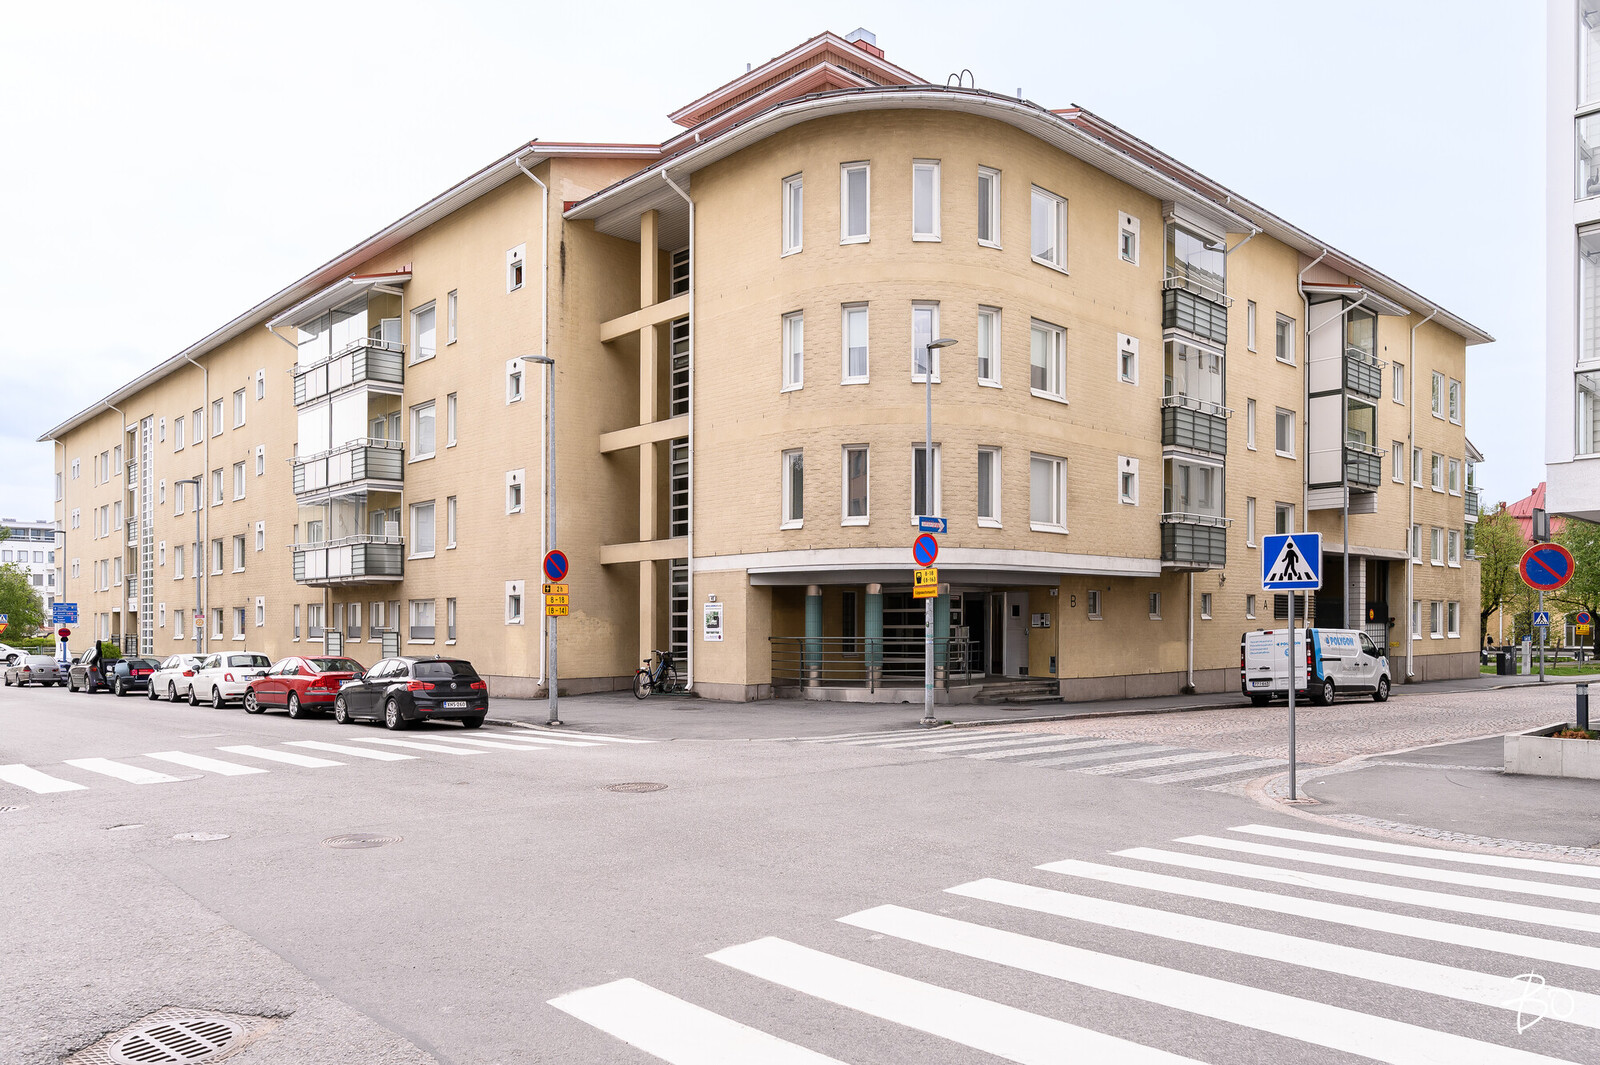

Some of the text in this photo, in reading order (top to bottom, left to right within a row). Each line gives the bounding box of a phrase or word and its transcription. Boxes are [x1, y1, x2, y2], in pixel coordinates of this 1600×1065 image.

[1070, 594, 1077, 608] B
[1263, 600, 1268, 610] A
[1330, 636, 1355, 646] POLYGON
